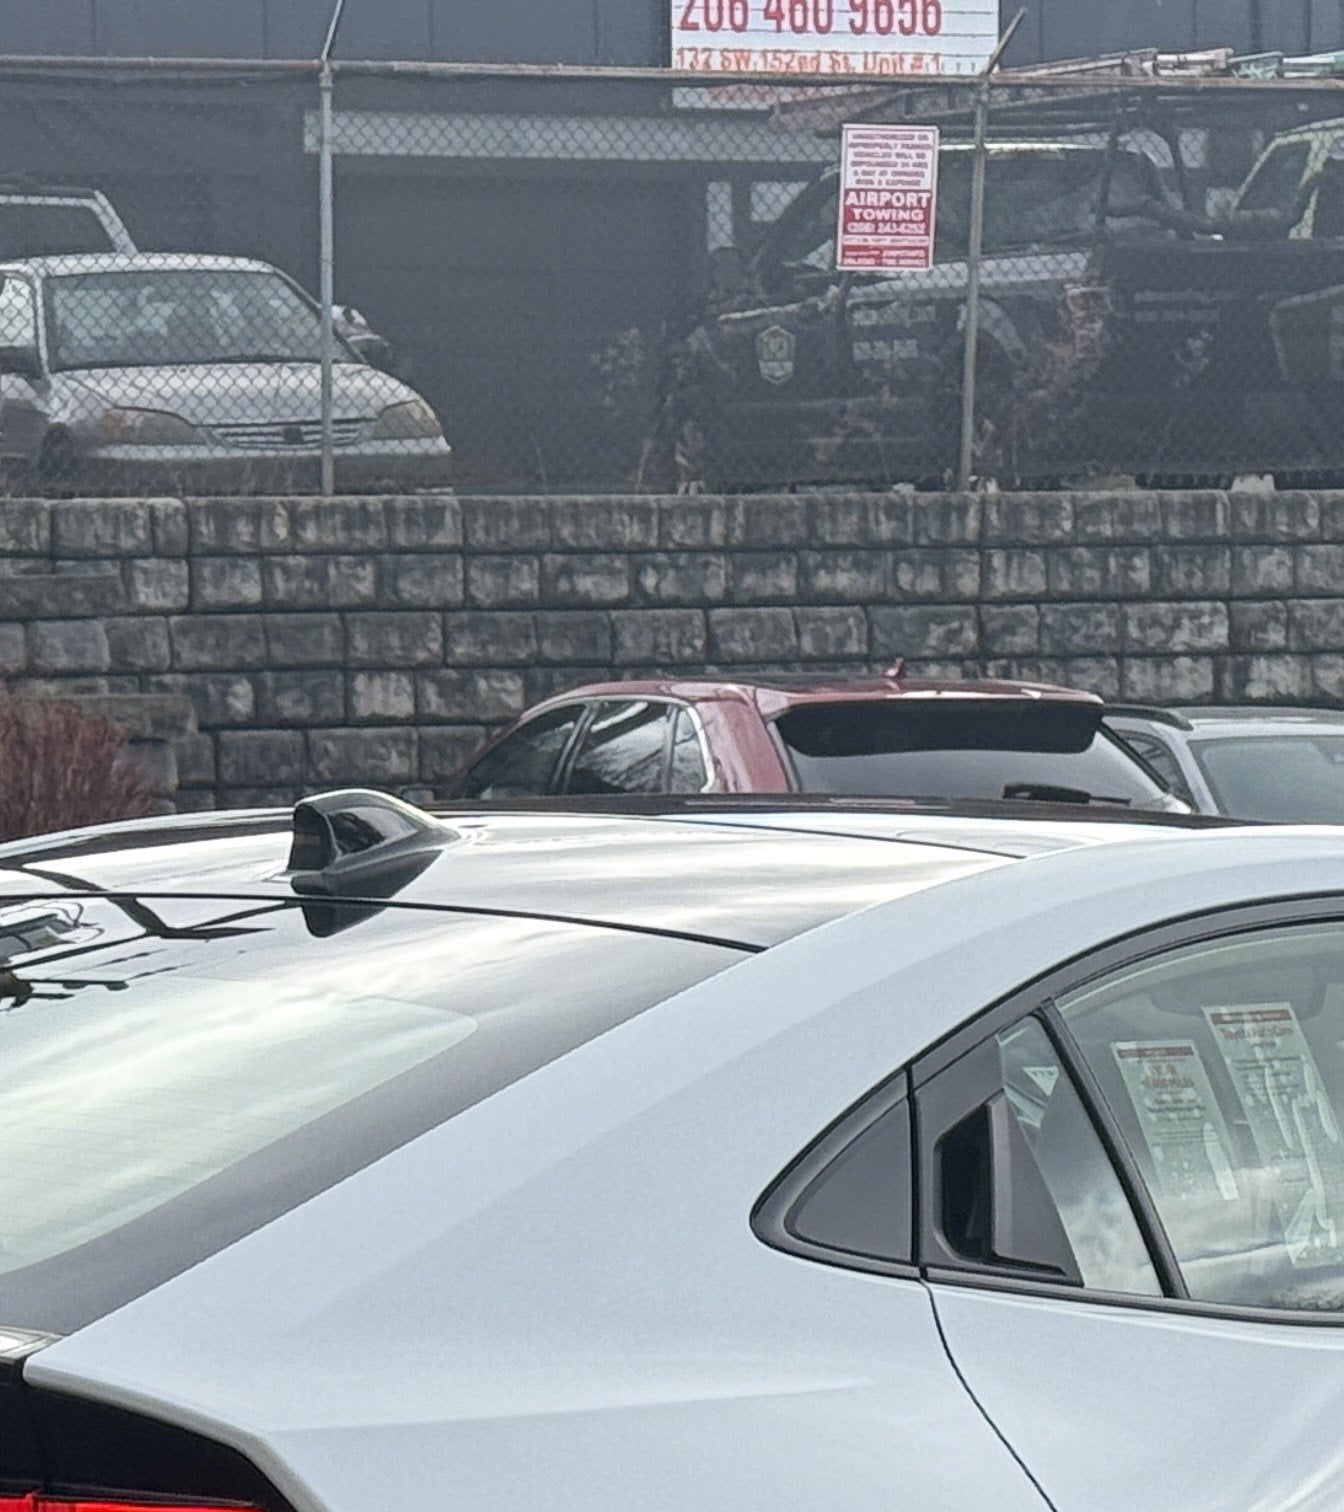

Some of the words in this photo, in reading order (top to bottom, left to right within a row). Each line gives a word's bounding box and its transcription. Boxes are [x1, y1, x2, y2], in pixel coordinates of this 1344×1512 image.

[679, 0, 748, 32] 206
[763, 0, 834, 34] 460
[845, 191, 931, 208] AIRPORT
[851, 208, 925, 221] TOWING
